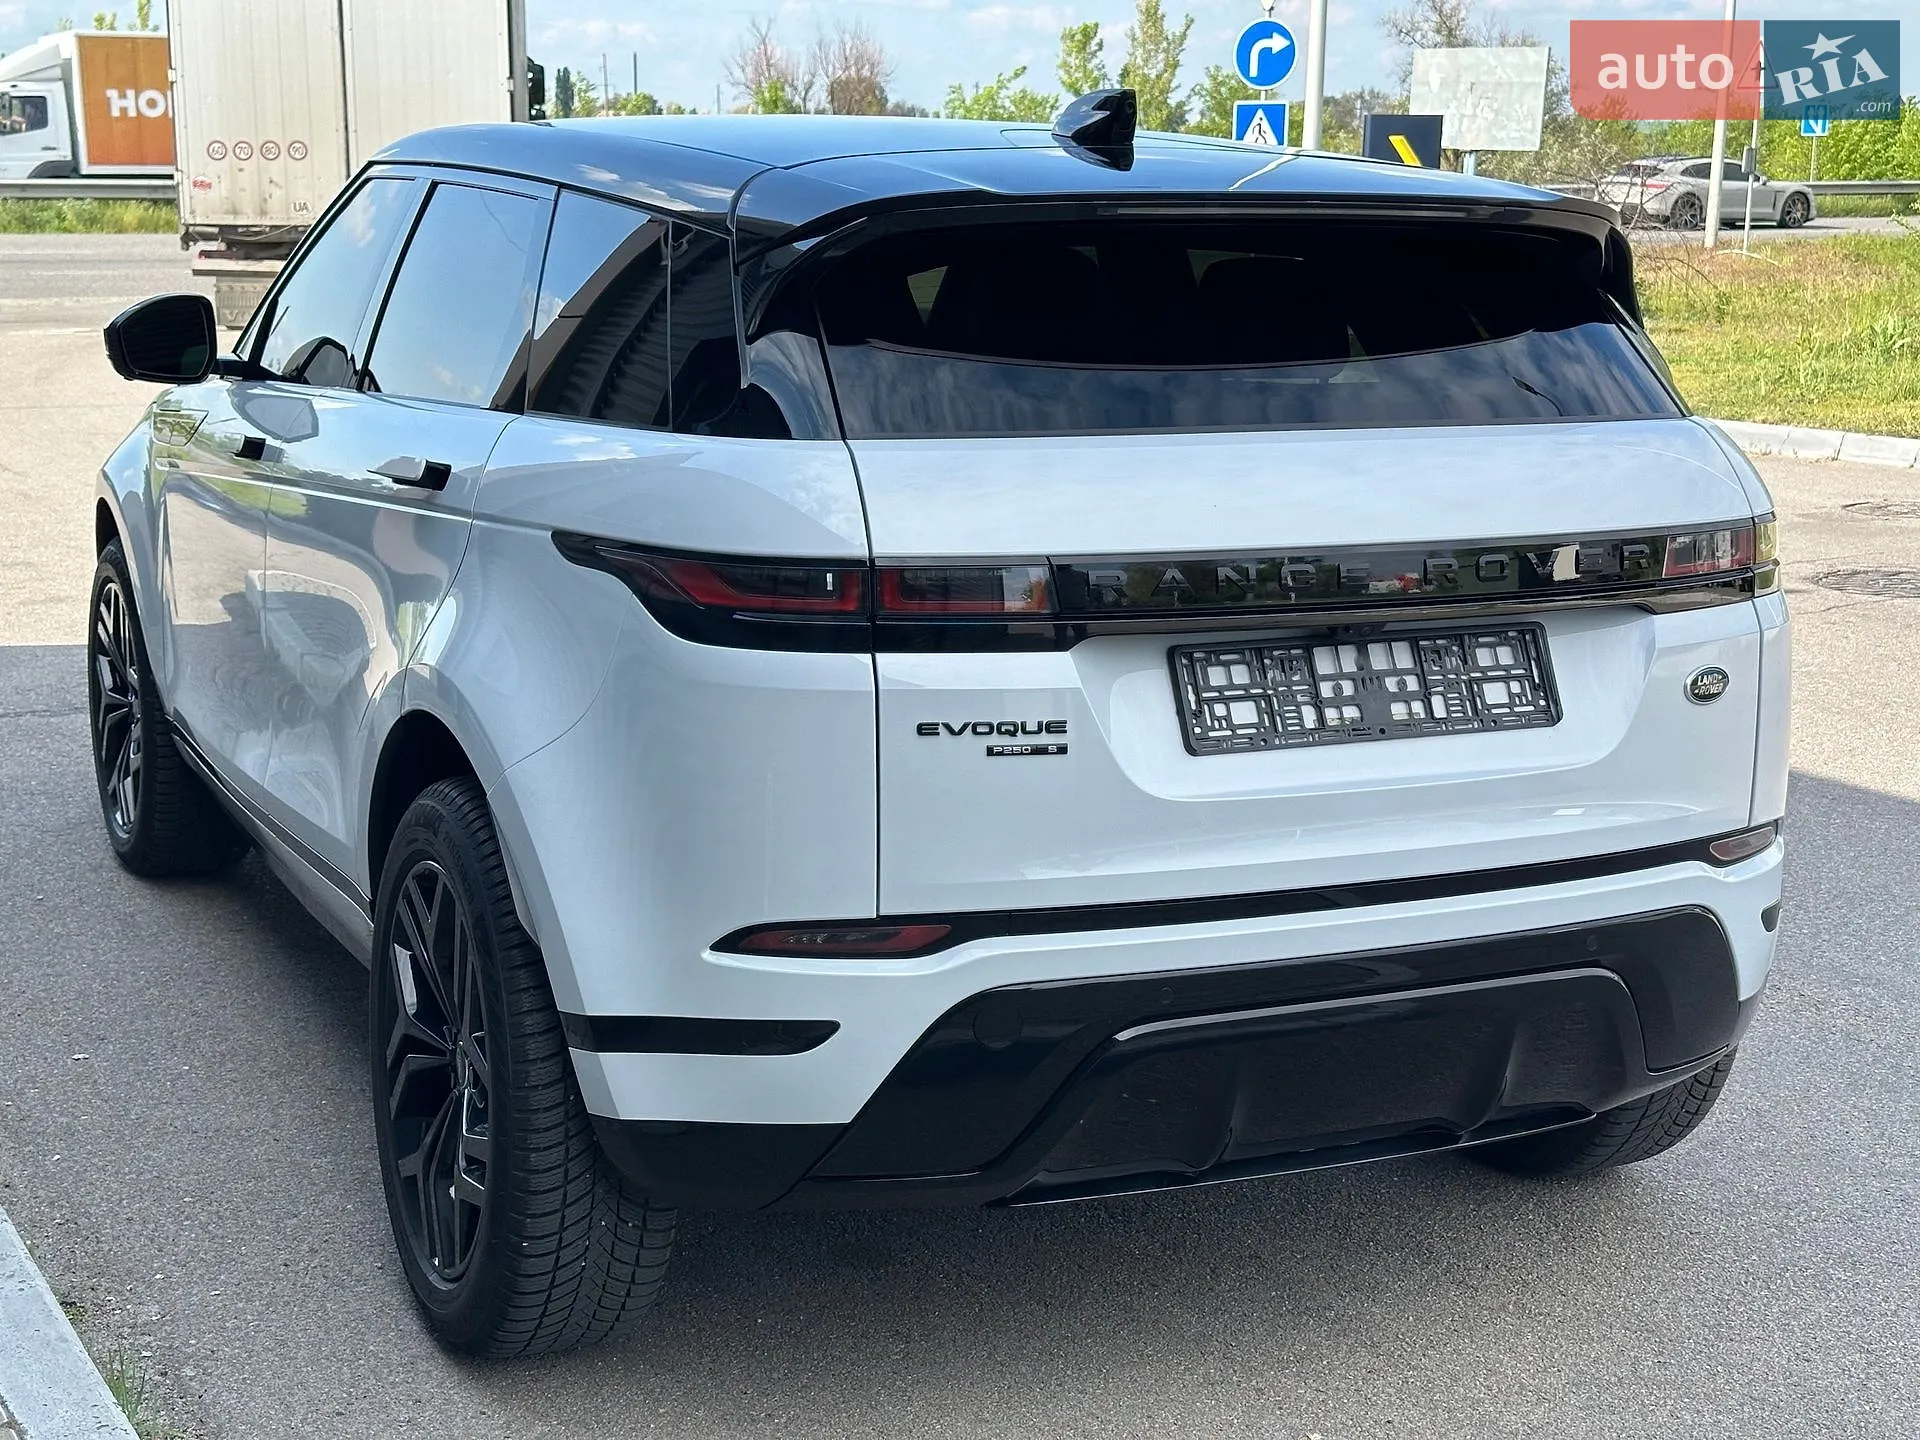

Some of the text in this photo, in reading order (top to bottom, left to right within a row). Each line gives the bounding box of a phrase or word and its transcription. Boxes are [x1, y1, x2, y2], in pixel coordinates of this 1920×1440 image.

[292, 201, 309, 213] UA
[1087, 544, 1650, 606] RANGE ROVER
[1697, 673, 1718, 686] LAND
[1698, 682, 1724, 696] ROVER
[916, 719, 1068, 738] EVOQUE
[993, 745, 1058, 755] P250 S
